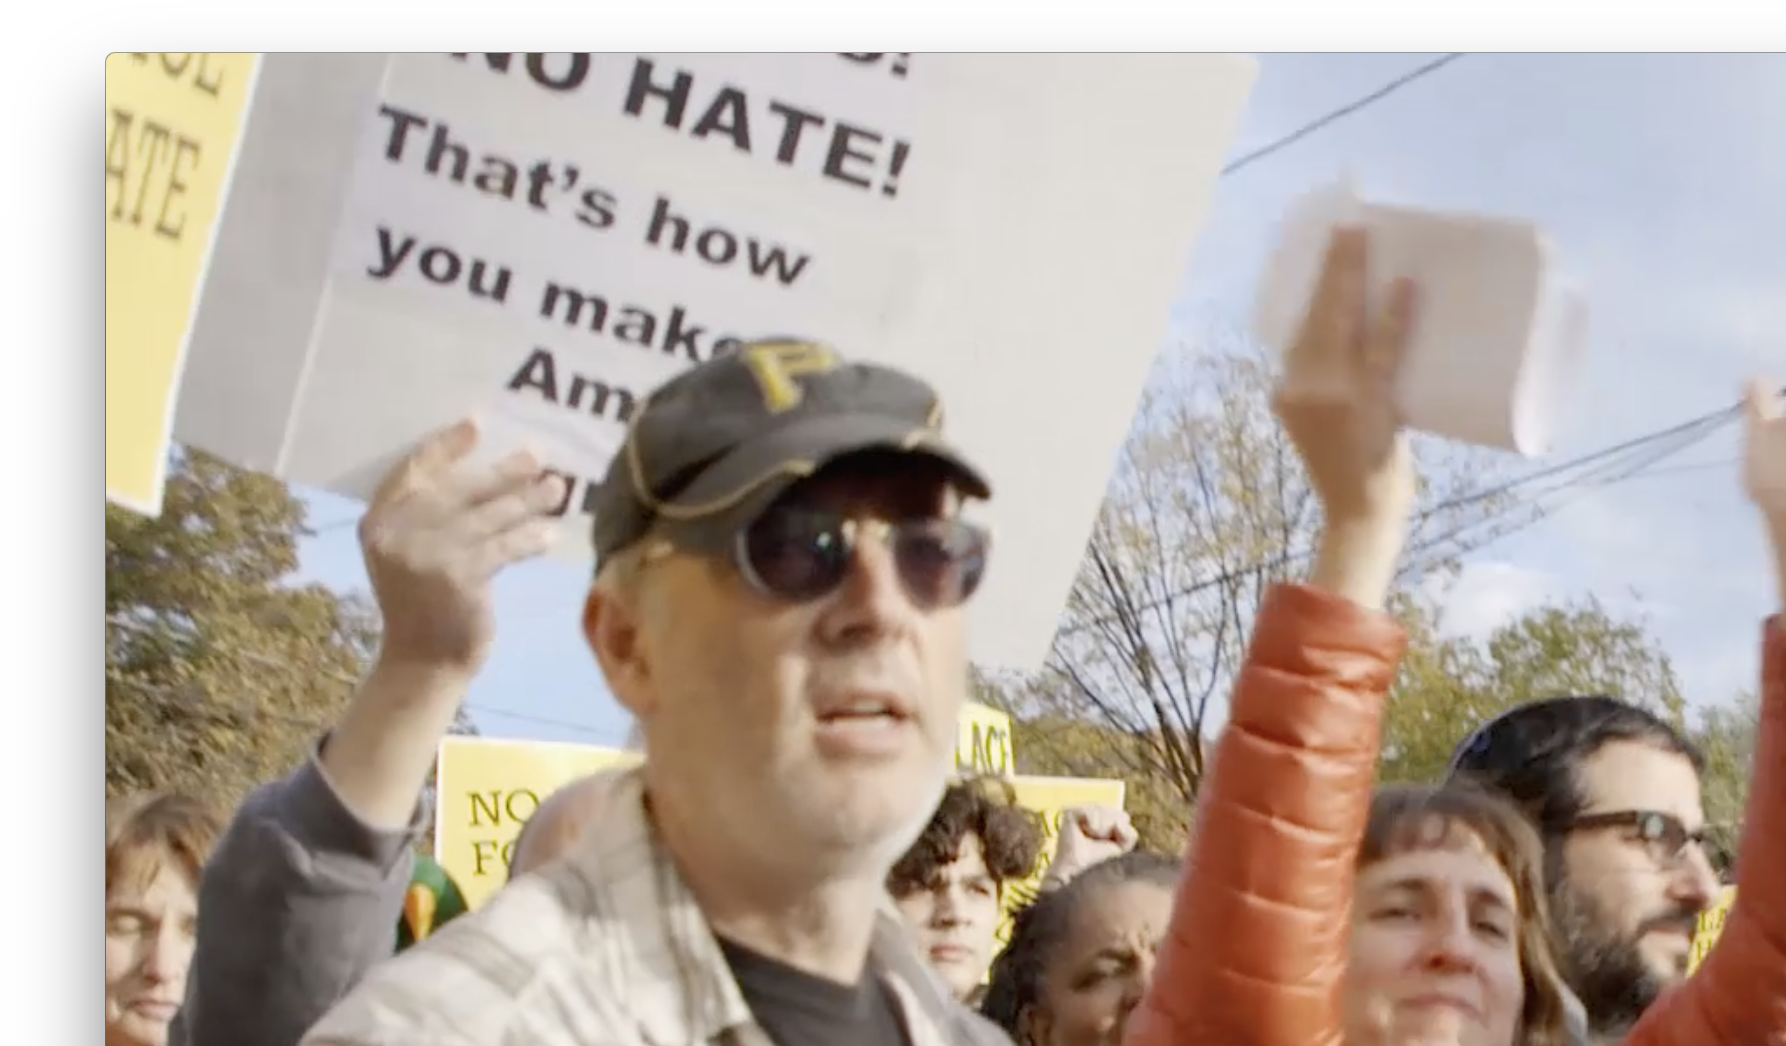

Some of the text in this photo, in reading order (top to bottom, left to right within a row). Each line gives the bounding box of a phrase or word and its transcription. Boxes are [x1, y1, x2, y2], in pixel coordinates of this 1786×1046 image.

[621, 56, 911, 198] HATE!
[106, 107, 203, 241] ATE
[366, 227, 512, 307] you
[645, 195, 814, 287] how
[505, 347, 637, 422] Am
[466, 788, 541, 827] NO
